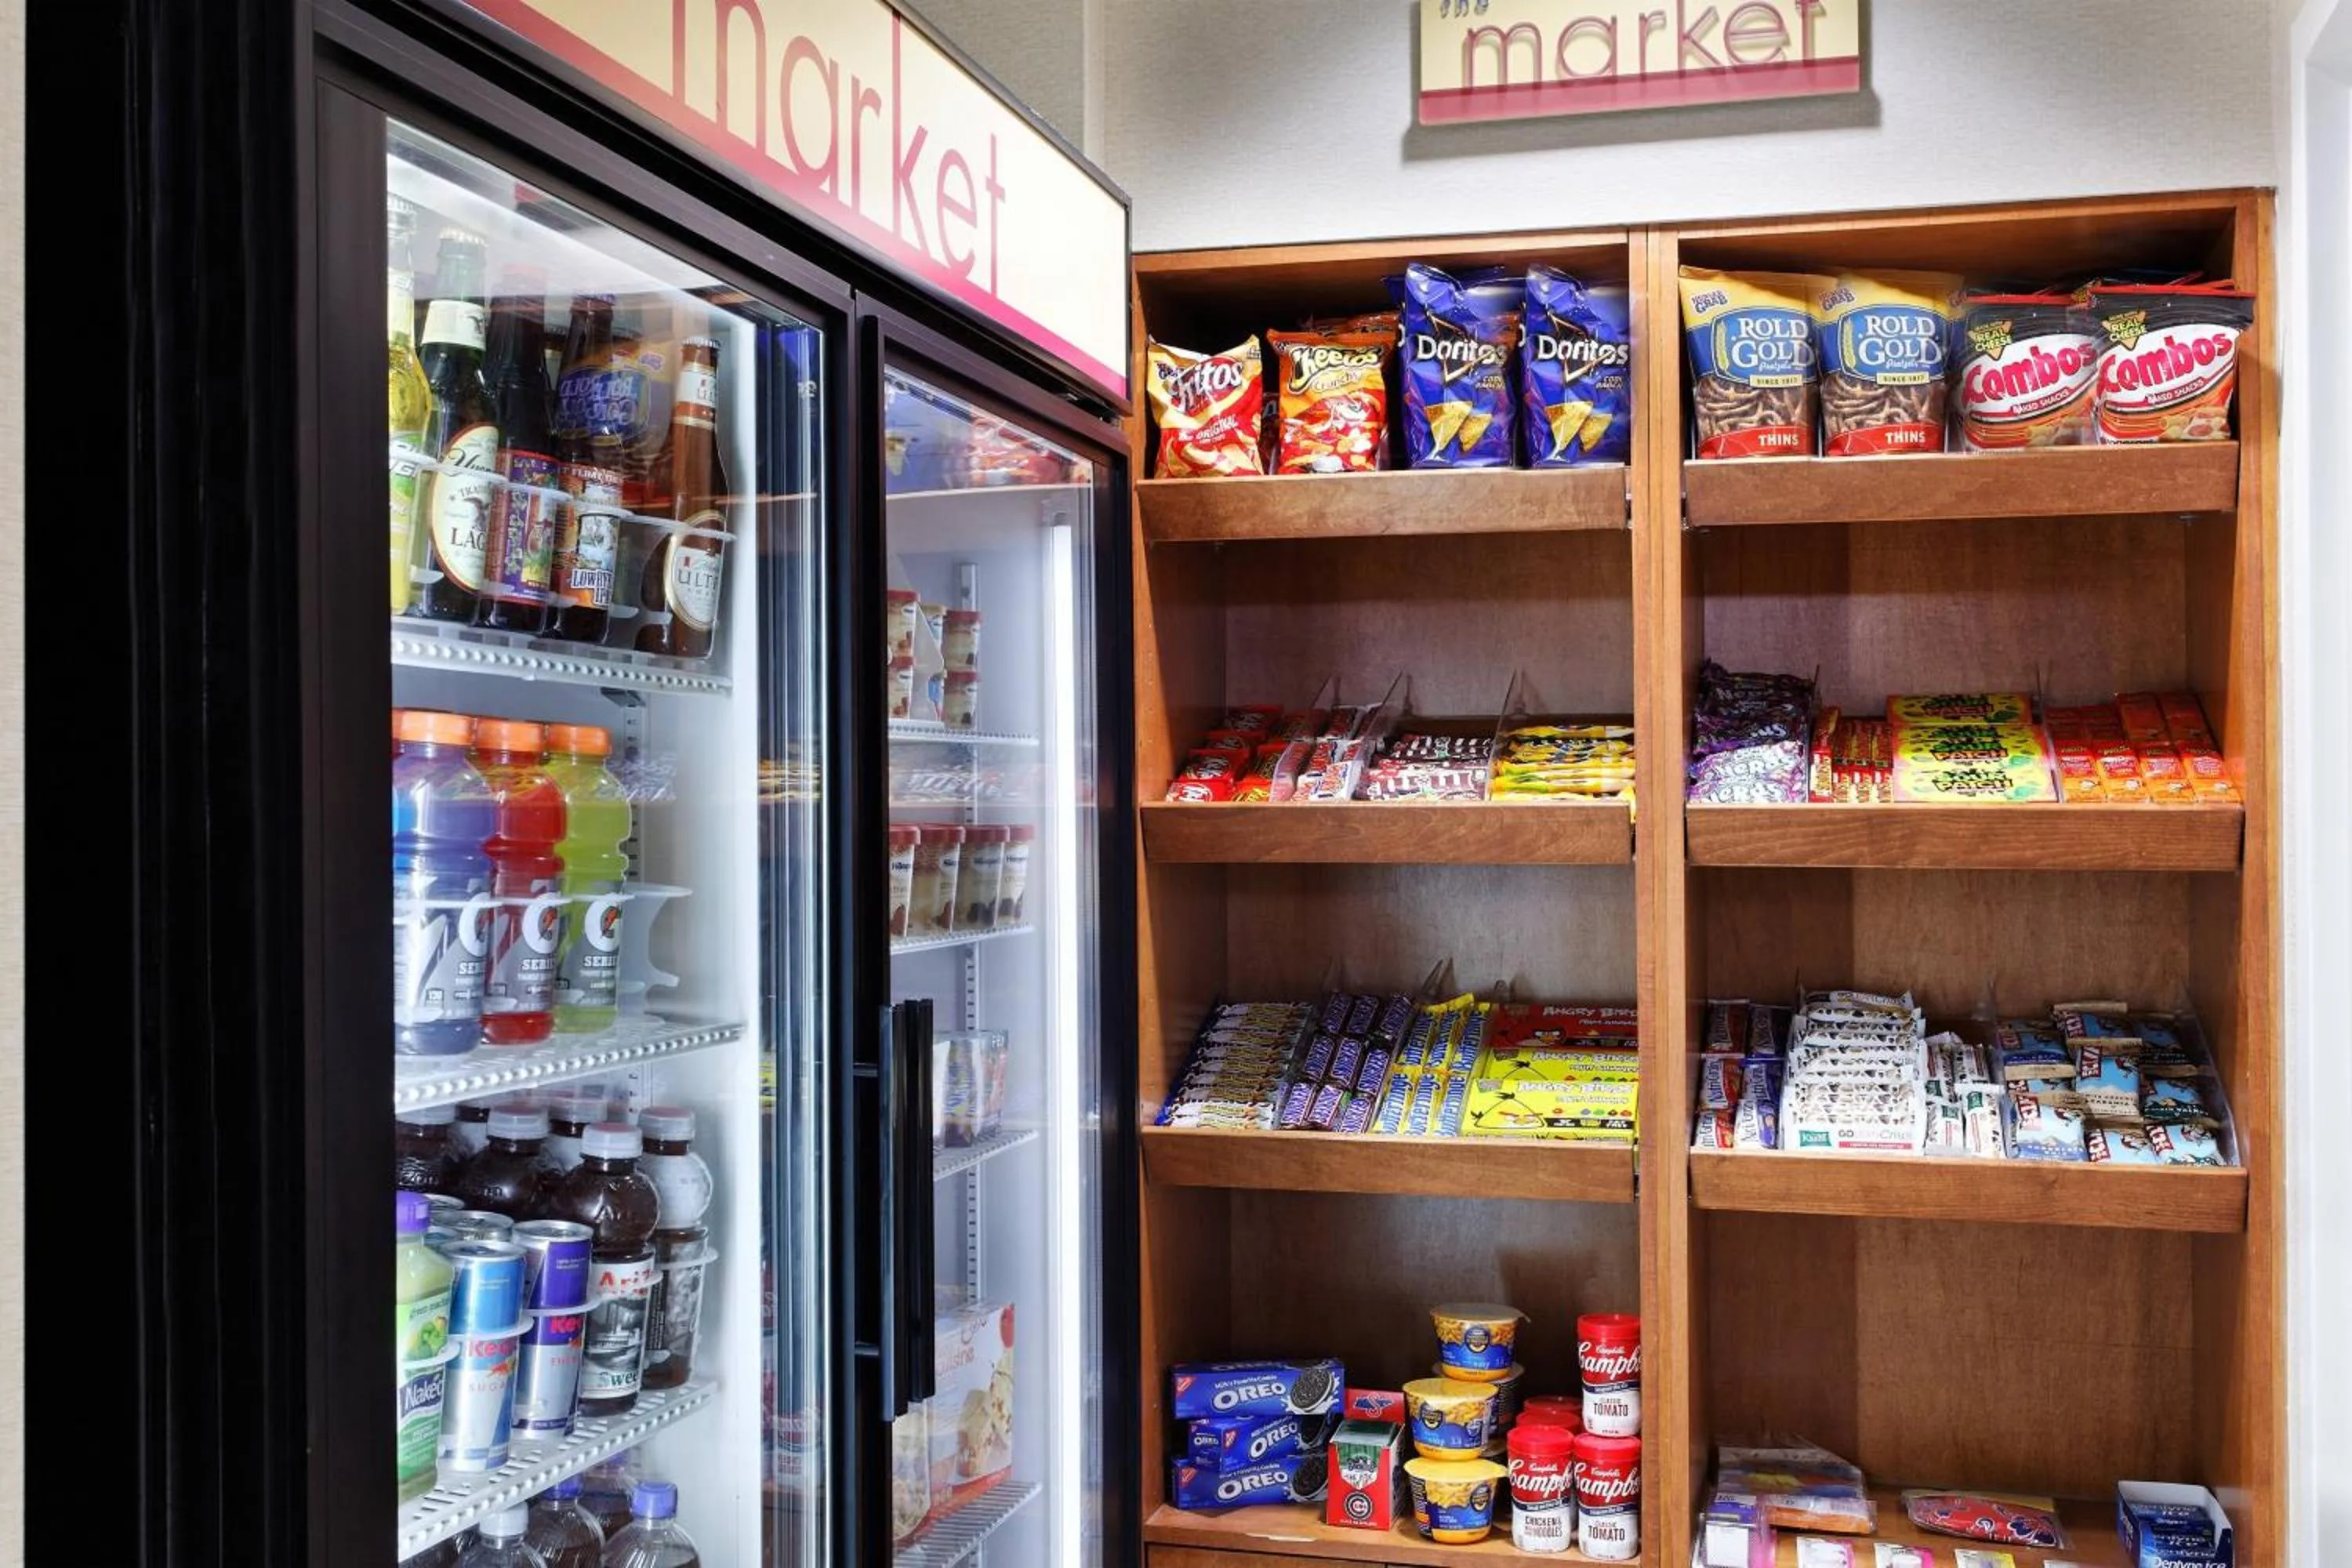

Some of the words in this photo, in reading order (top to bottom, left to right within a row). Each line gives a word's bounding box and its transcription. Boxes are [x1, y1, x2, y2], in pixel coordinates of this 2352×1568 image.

[1463, 0, 1826, 90] market
[673, 0, 1006, 298] market
[1737, 317, 1809, 339] ROLD
[1864, 315, 1936, 338] ROLD
[1417, 335, 1507, 366] Doritos
[1537, 335, 1629, 366] Doritos
[1731, 339, 1815, 368] GOLD
[1858, 337, 1943, 366] GOLD
[1962, 343, 2100, 405] Combos
[2096, 333, 2233, 398] Combos
[1759, 434, 1798, 447] THINS
[1885, 431, 1926, 445] THINS
[1213, 1382, 1287, 1411] OREO
[1593, 1403, 1629, 1417] TOMATO
[1250, 1421, 1298, 1458] OREO
[1217, 1471, 1288, 1500] OREO
[1588, 1526, 1626, 1541] TOMATO
